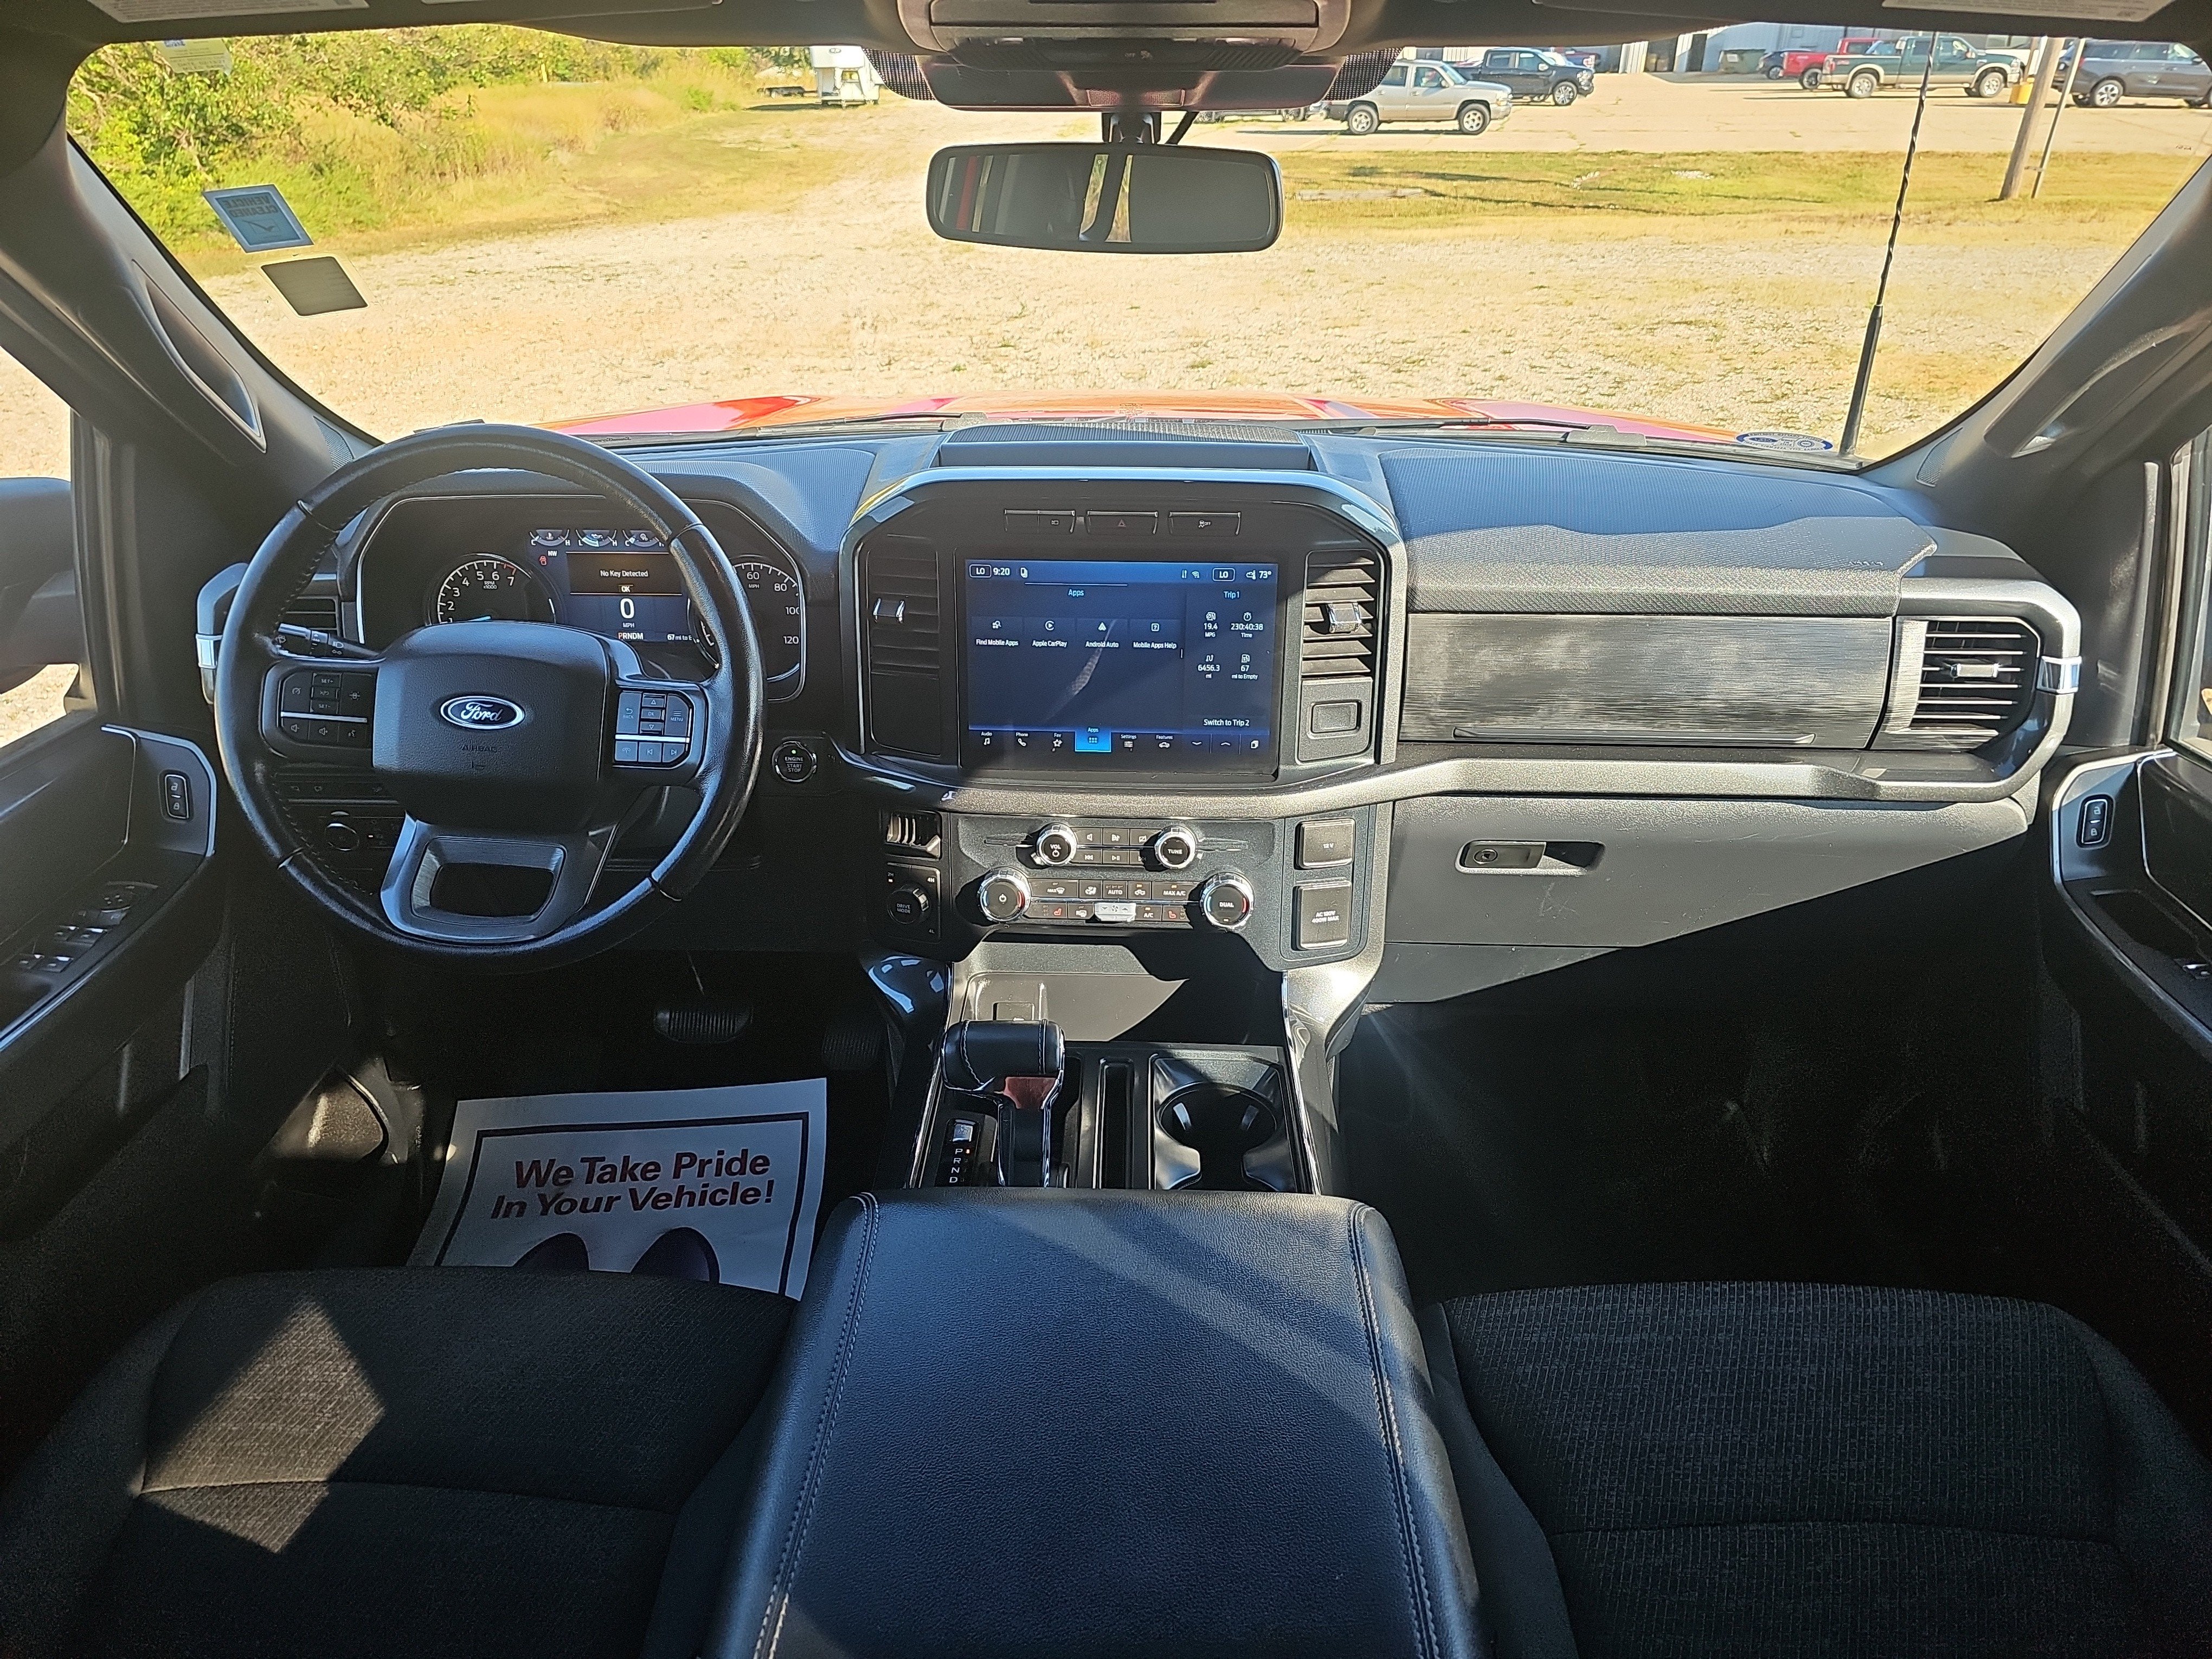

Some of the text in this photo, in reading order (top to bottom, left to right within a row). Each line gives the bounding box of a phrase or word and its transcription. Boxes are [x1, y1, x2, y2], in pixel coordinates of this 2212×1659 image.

[477, 571, 484, 580] 5
[492, 571, 500, 581] 6
[462, 577, 470, 586] 4
[507, 577, 515, 586] 7
[453, 587, 460, 596] 3
[447, 601, 454, 610] 2
[620, 598, 634, 619] 0
[460, 702, 503, 721] Ford
[515, 1148, 770, 1189] We Take Pride
[491, 1179, 775, 1219] In Your Vehicle!
